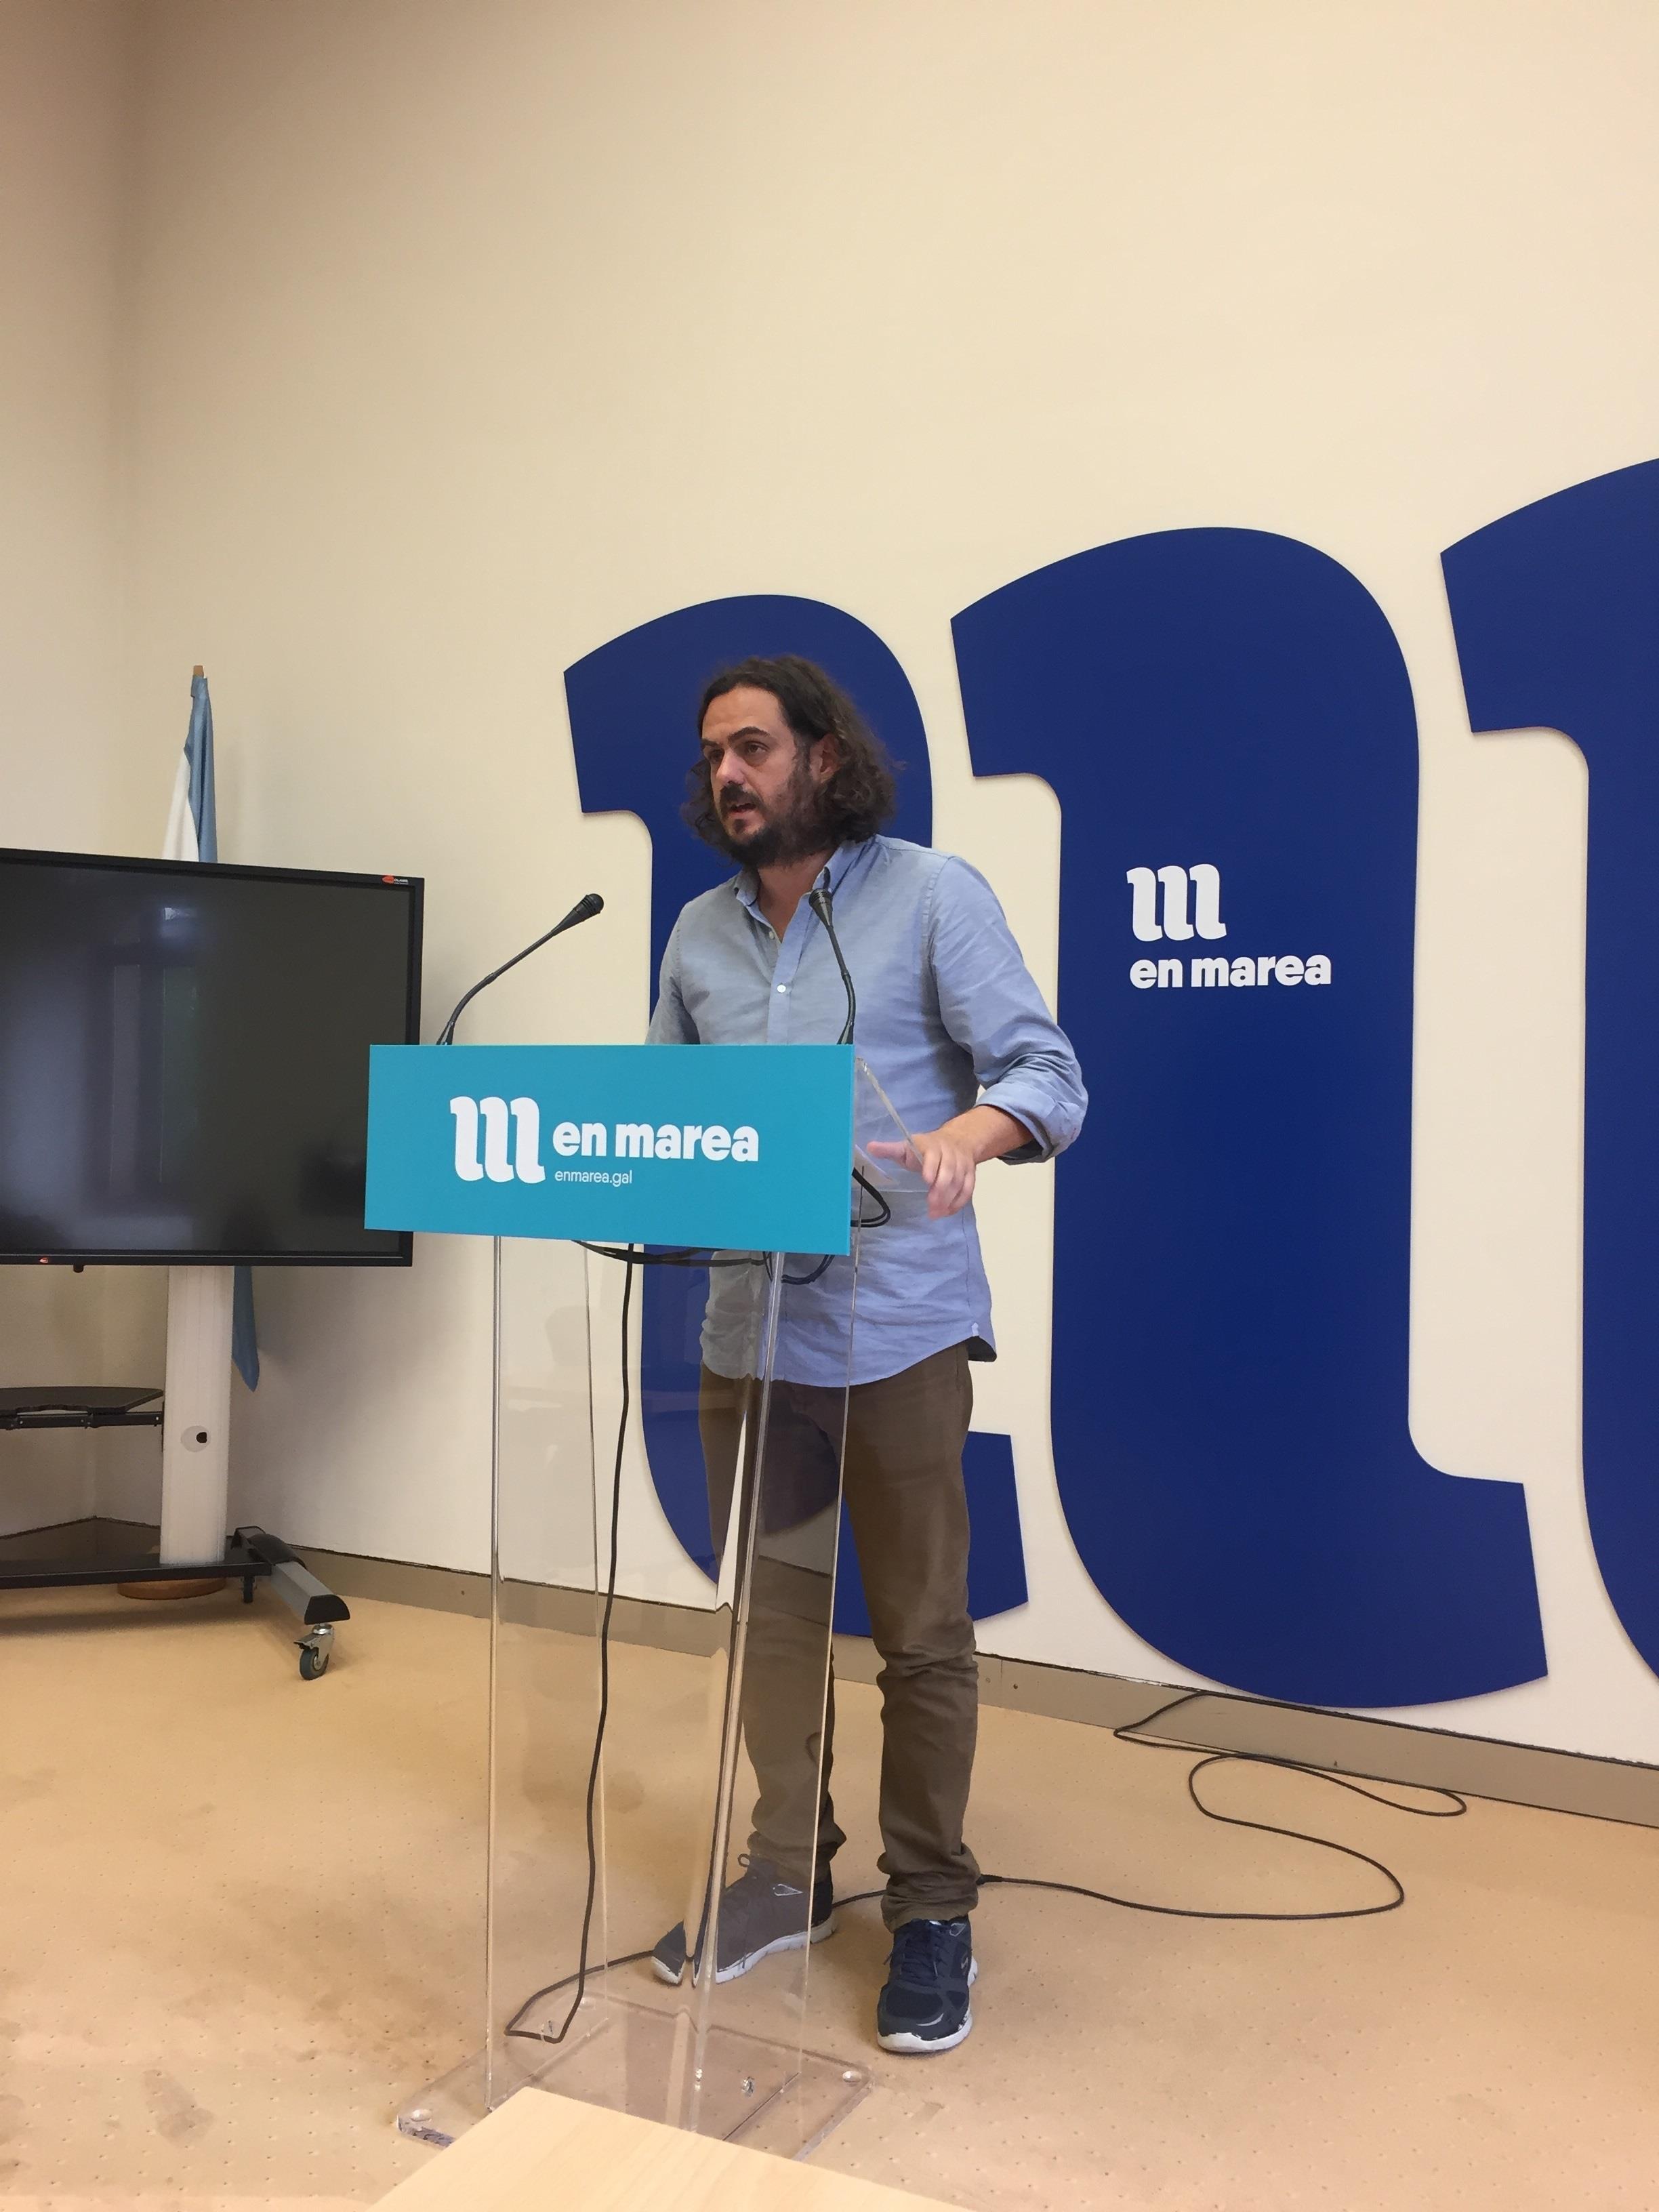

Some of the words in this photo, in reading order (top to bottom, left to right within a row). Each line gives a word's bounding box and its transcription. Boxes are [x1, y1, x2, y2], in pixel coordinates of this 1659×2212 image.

[1129, 958, 1183, 989] en
[1191, 954, 1332, 987] marea
[552, 1122, 607, 1157] en
[615, 1123, 759, 1162] marea
[554, 1169, 633, 1187] enmarea.gal
